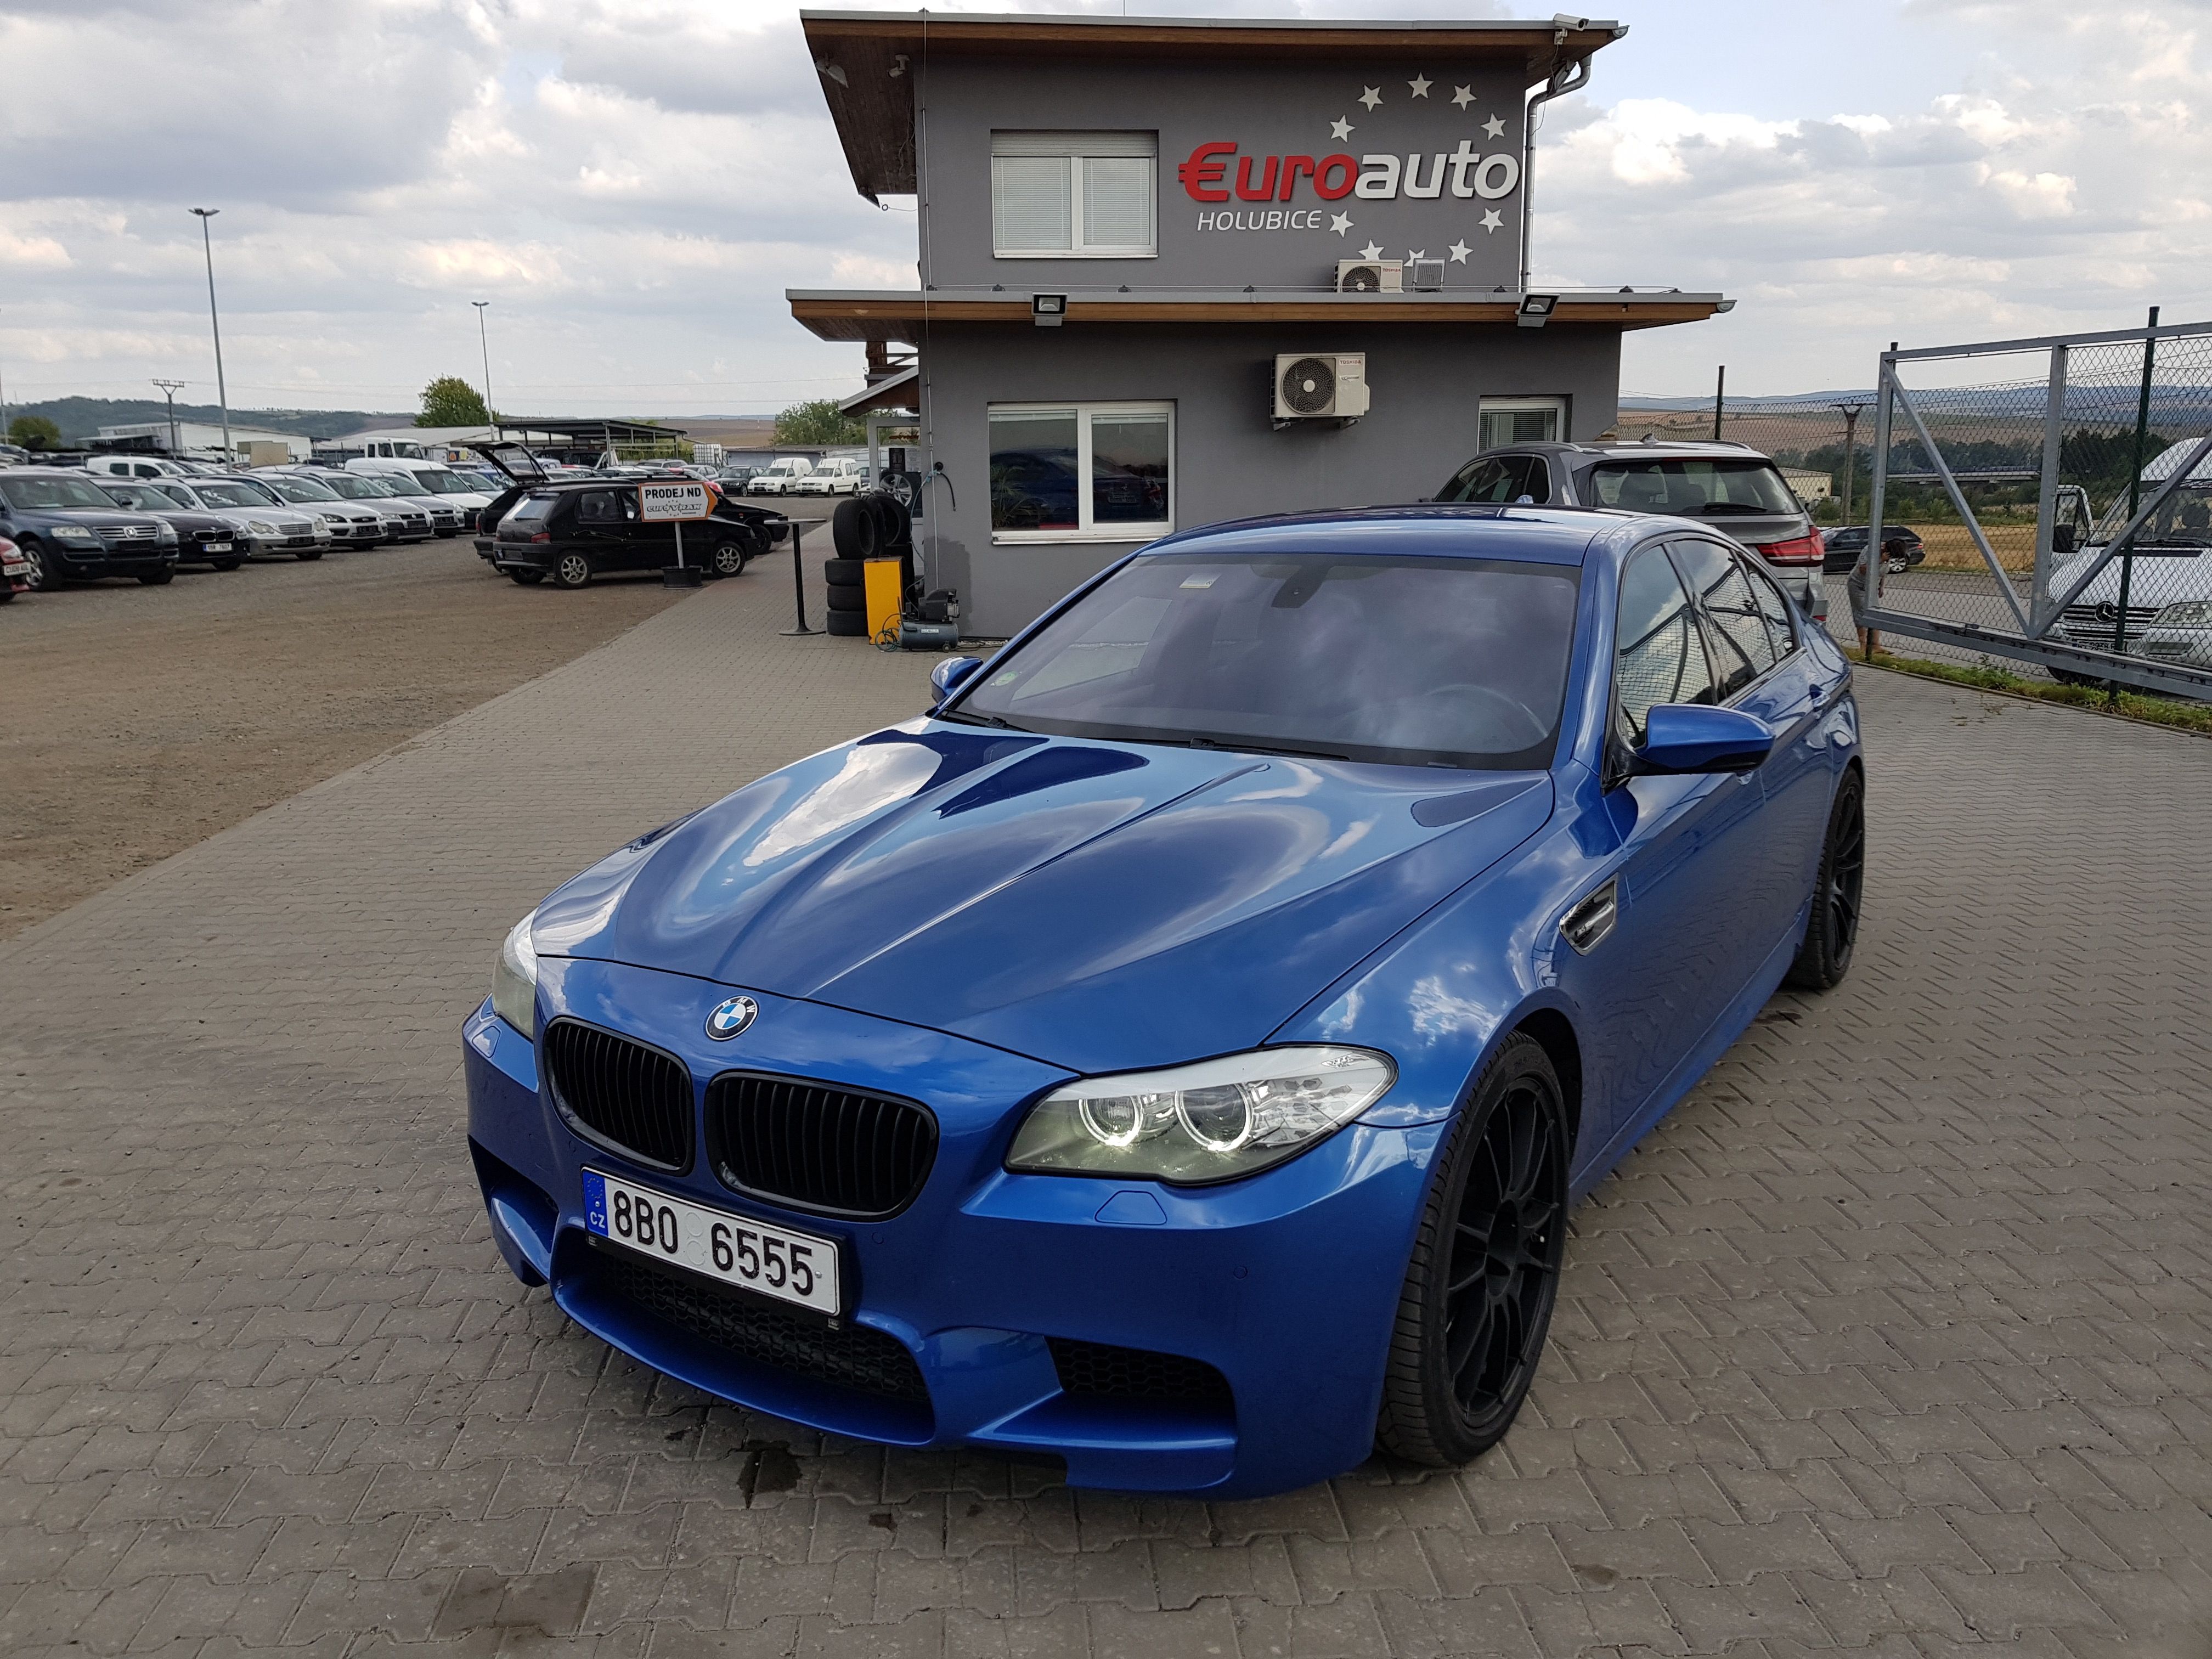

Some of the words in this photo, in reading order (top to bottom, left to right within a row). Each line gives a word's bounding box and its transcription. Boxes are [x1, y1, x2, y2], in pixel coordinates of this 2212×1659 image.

[1197, 210, 1322, 231] HOLUBICE
[645, 488, 684, 499] PRODEJ
[687, 487, 701, 497] ND
[590, 1211, 606, 1228] CZ
[711, 1222, 814, 1296] 6555
